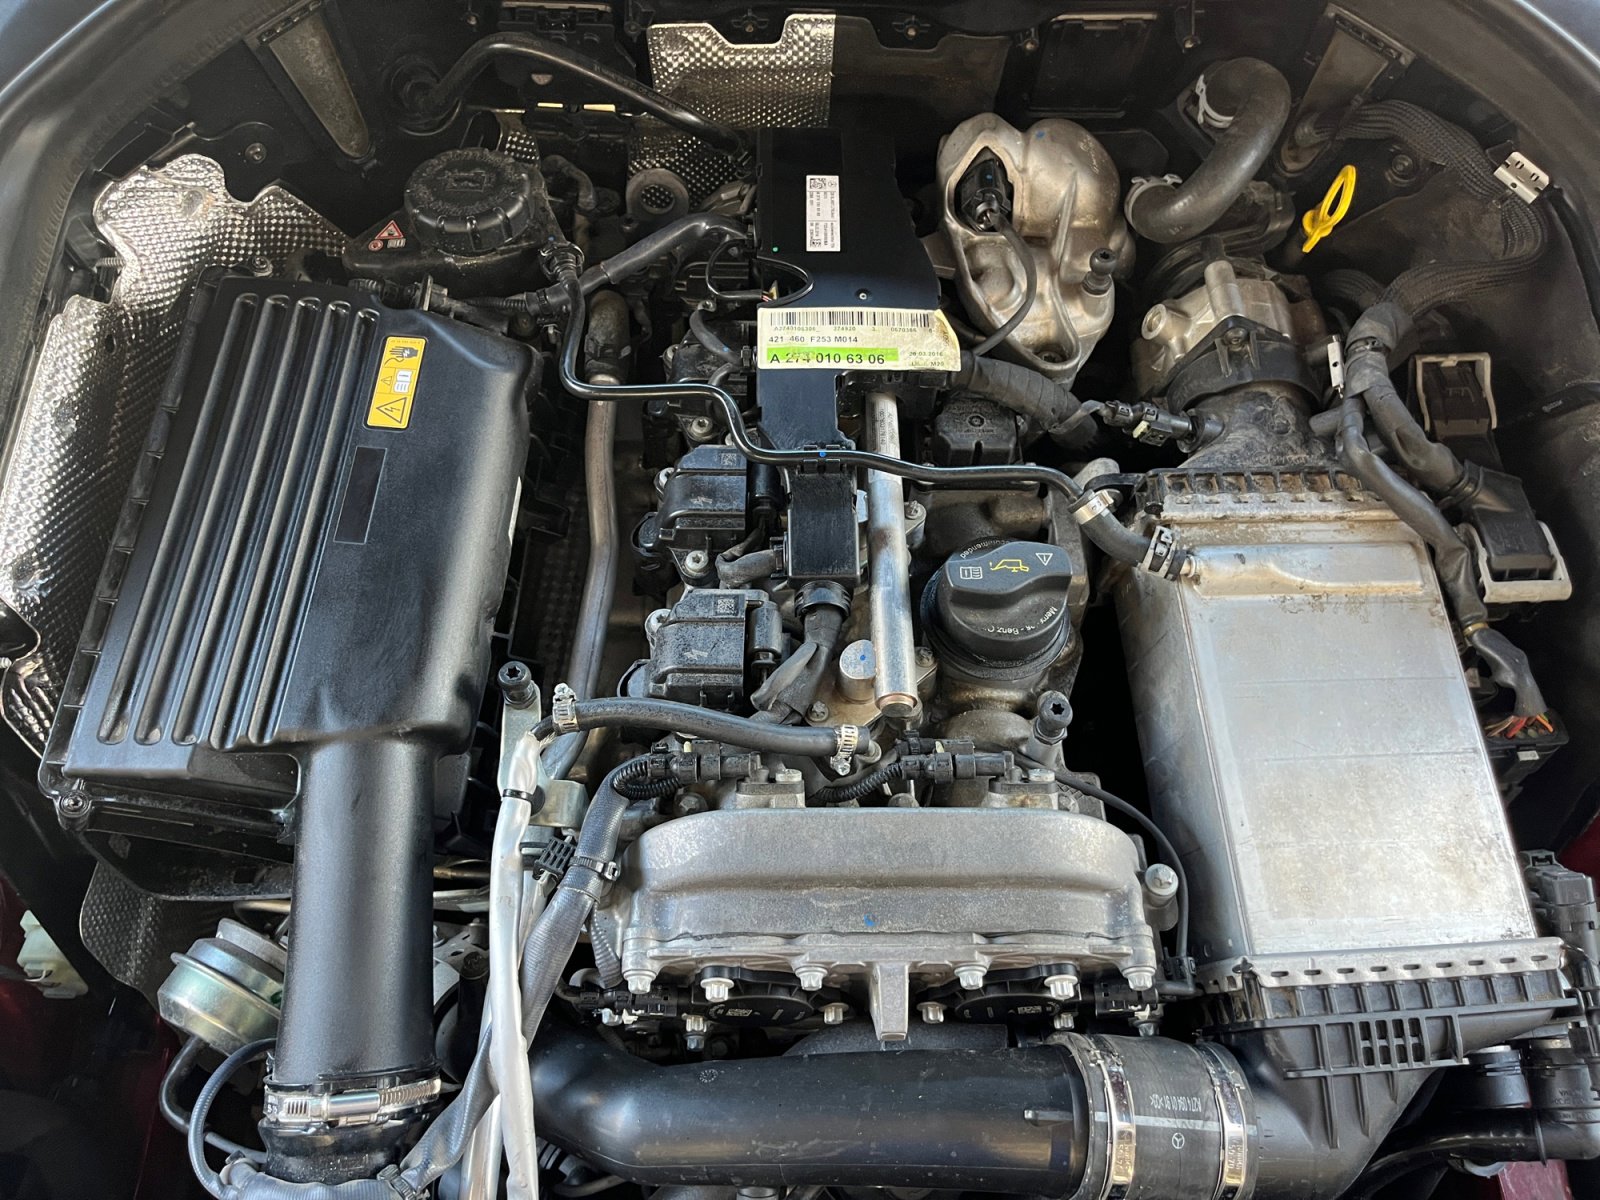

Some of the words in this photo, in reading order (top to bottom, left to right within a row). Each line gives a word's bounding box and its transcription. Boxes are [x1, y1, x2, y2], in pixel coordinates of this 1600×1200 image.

[770, 353, 780, 364] A
[816, 353, 841, 364] 010
[846, 354, 863, 364] 63
[868, 354, 885, 365] 06
